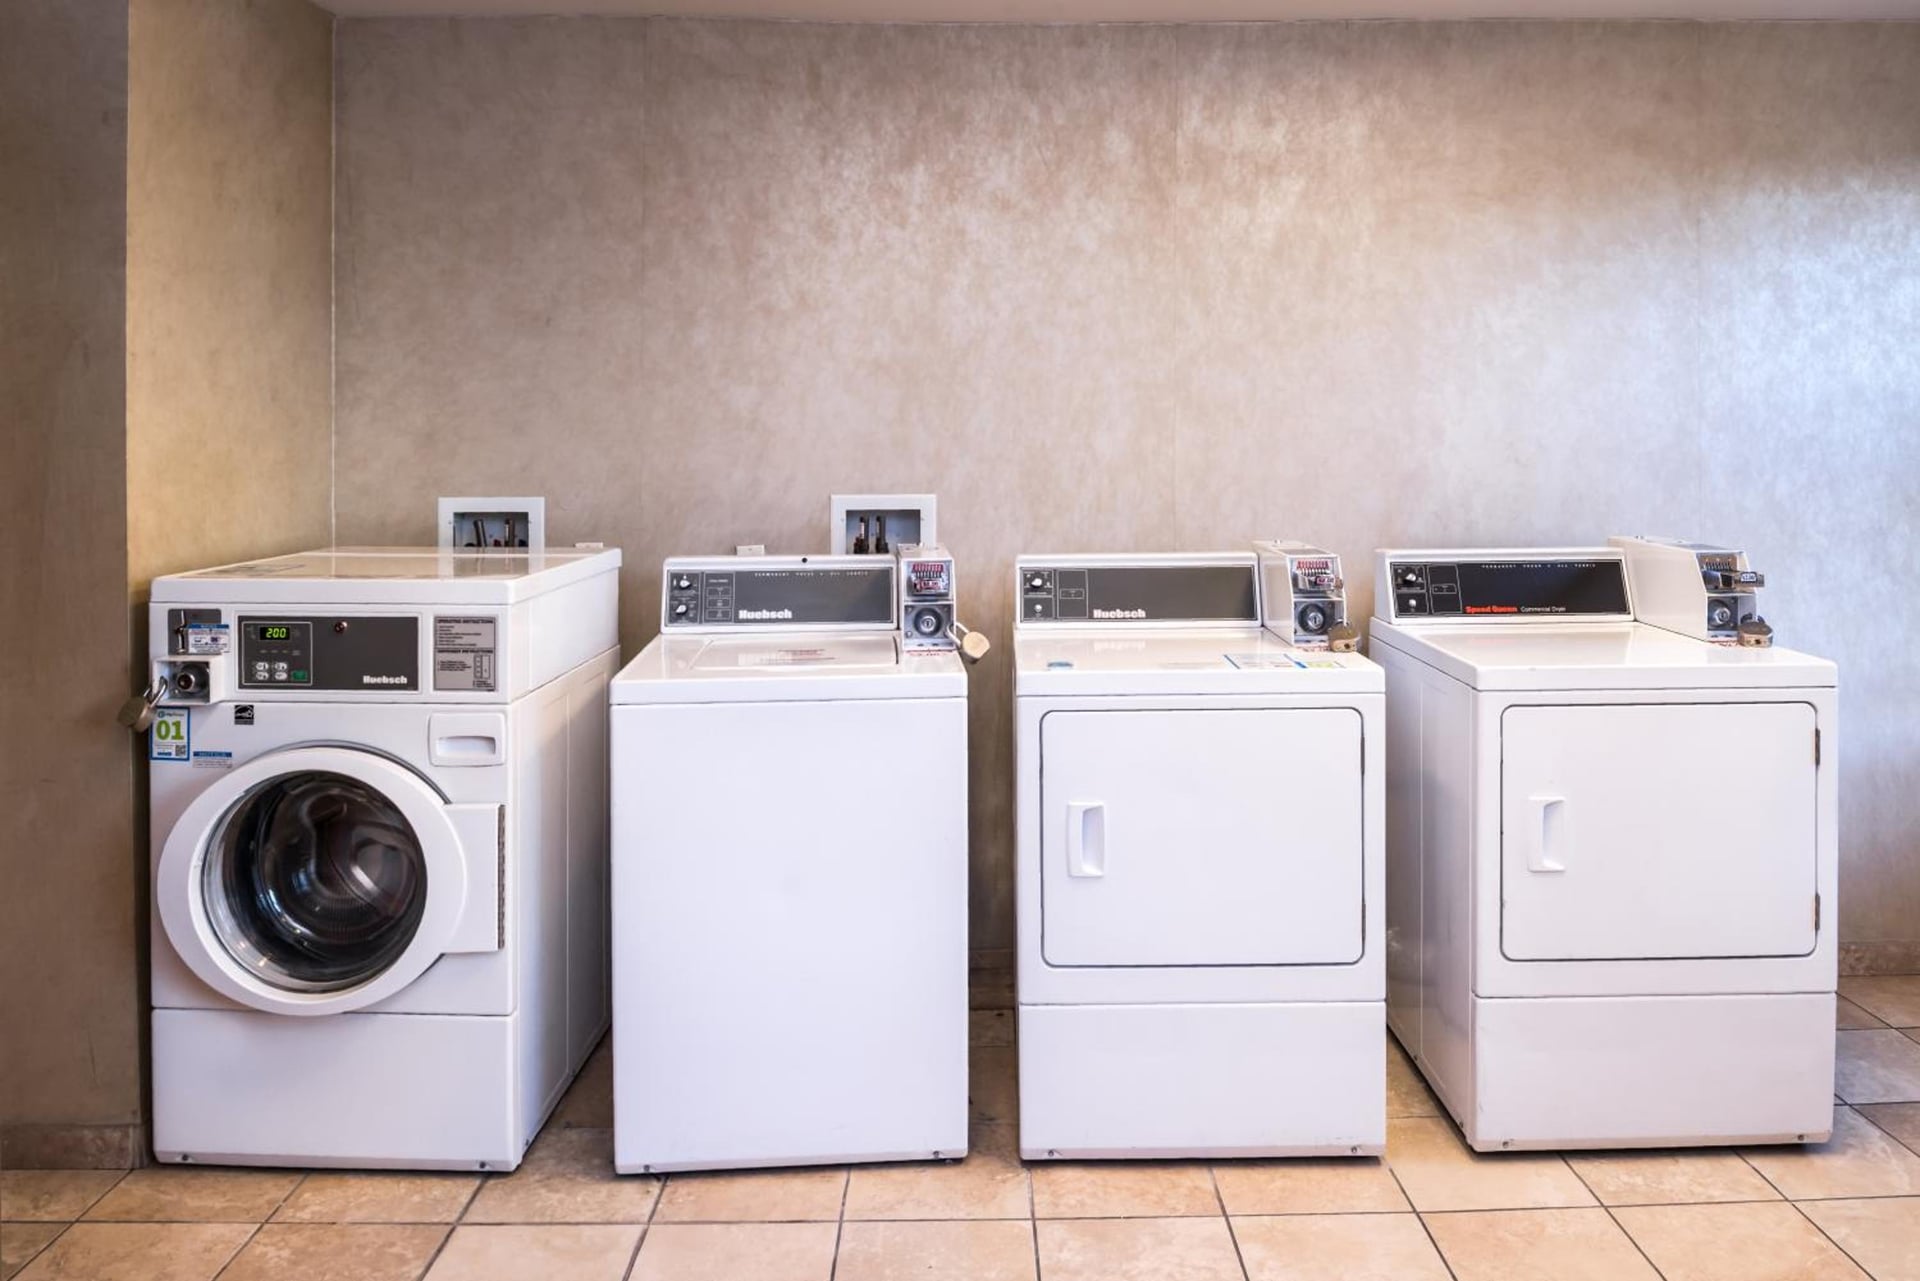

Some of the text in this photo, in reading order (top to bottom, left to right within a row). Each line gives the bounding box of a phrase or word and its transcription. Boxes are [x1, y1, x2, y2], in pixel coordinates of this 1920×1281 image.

[738, 607, 793, 620] Huebsch
[1092, 607, 1147, 619] Huebsch
[265, 627, 287, 639] 200
[362, 674, 408, 685] Huebsch
[156, 719, 185, 741] 01
